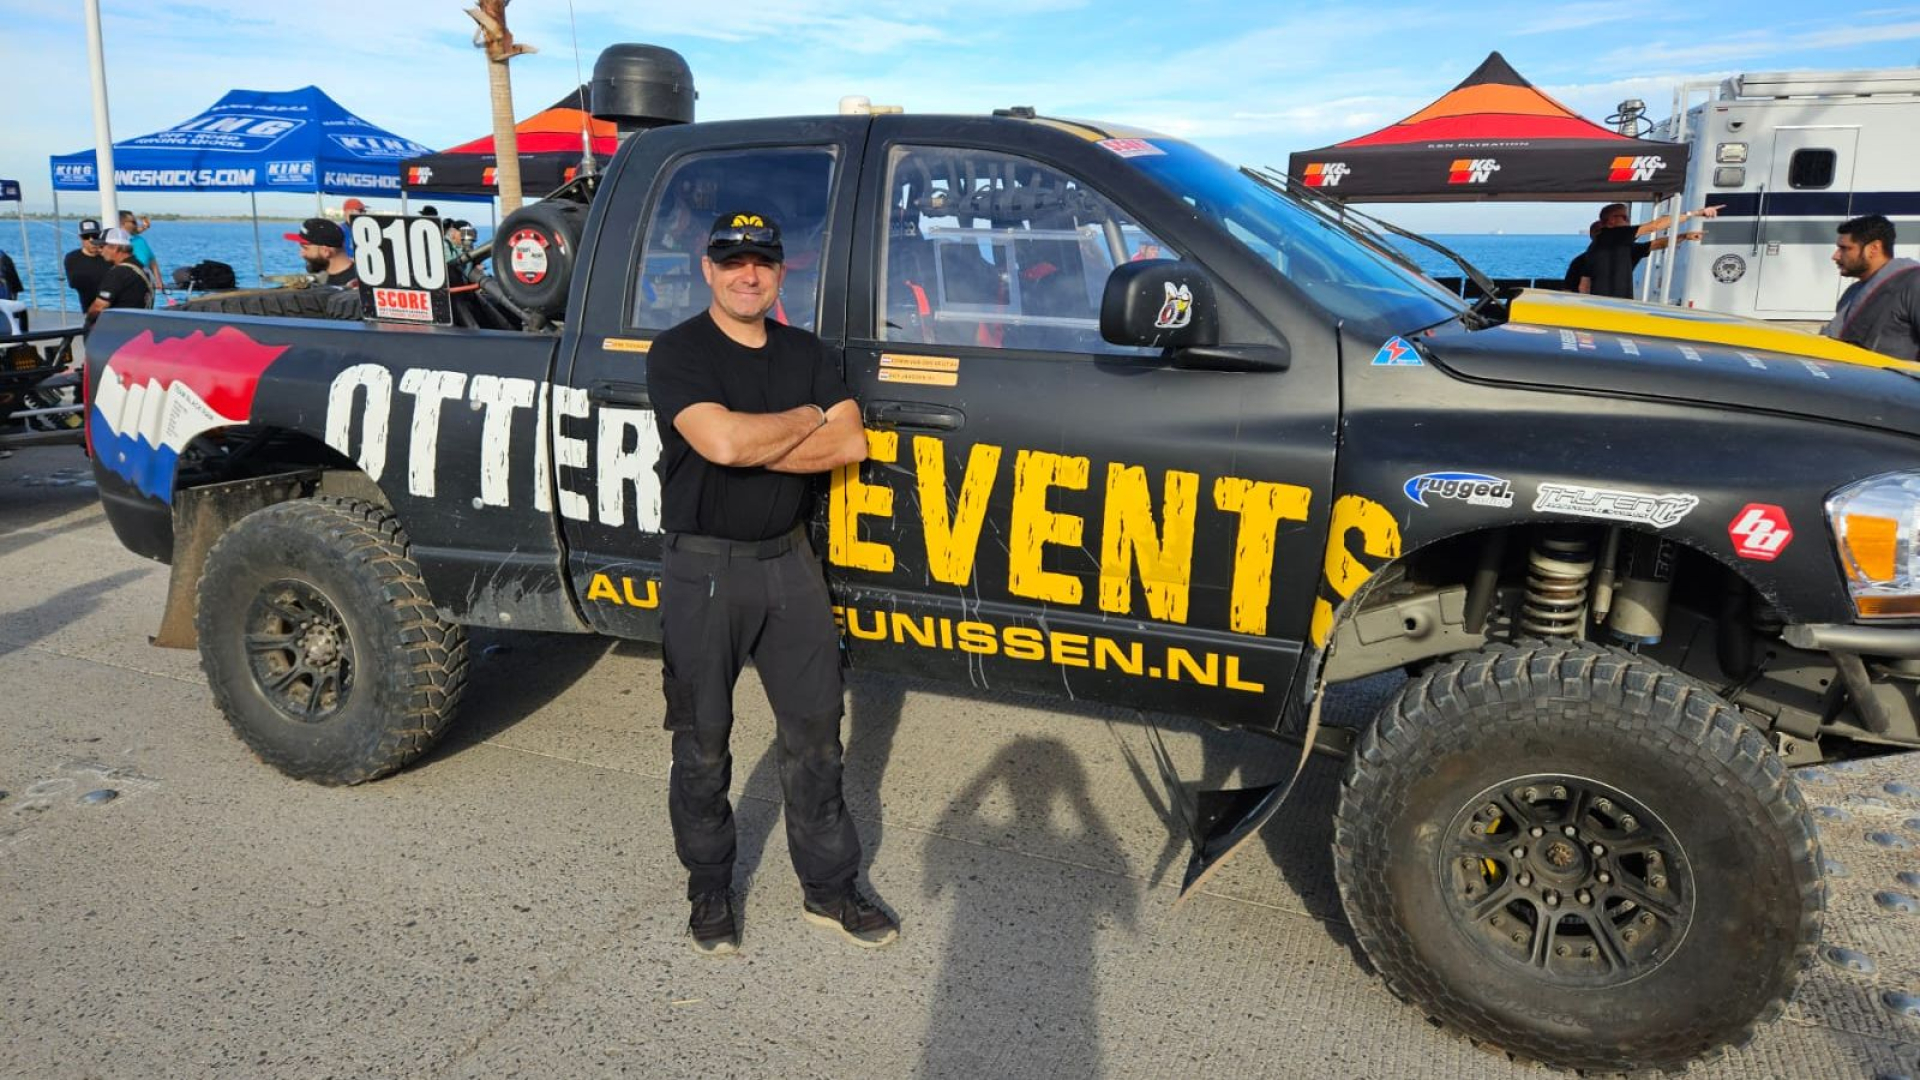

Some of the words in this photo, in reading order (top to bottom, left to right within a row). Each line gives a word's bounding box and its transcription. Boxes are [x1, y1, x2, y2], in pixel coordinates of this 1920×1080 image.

[56, 165, 92, 175] KING
[114, 169, 257, 187] INGSHOCKS.COM
[268, 162, 313, 175] KING
[352, 216, 446, 290] 810
[376, 290, 430, 310] SCORE
[324, 363, 664, 534] OTTER
[828, 428, 1402, 650] EVENTS
